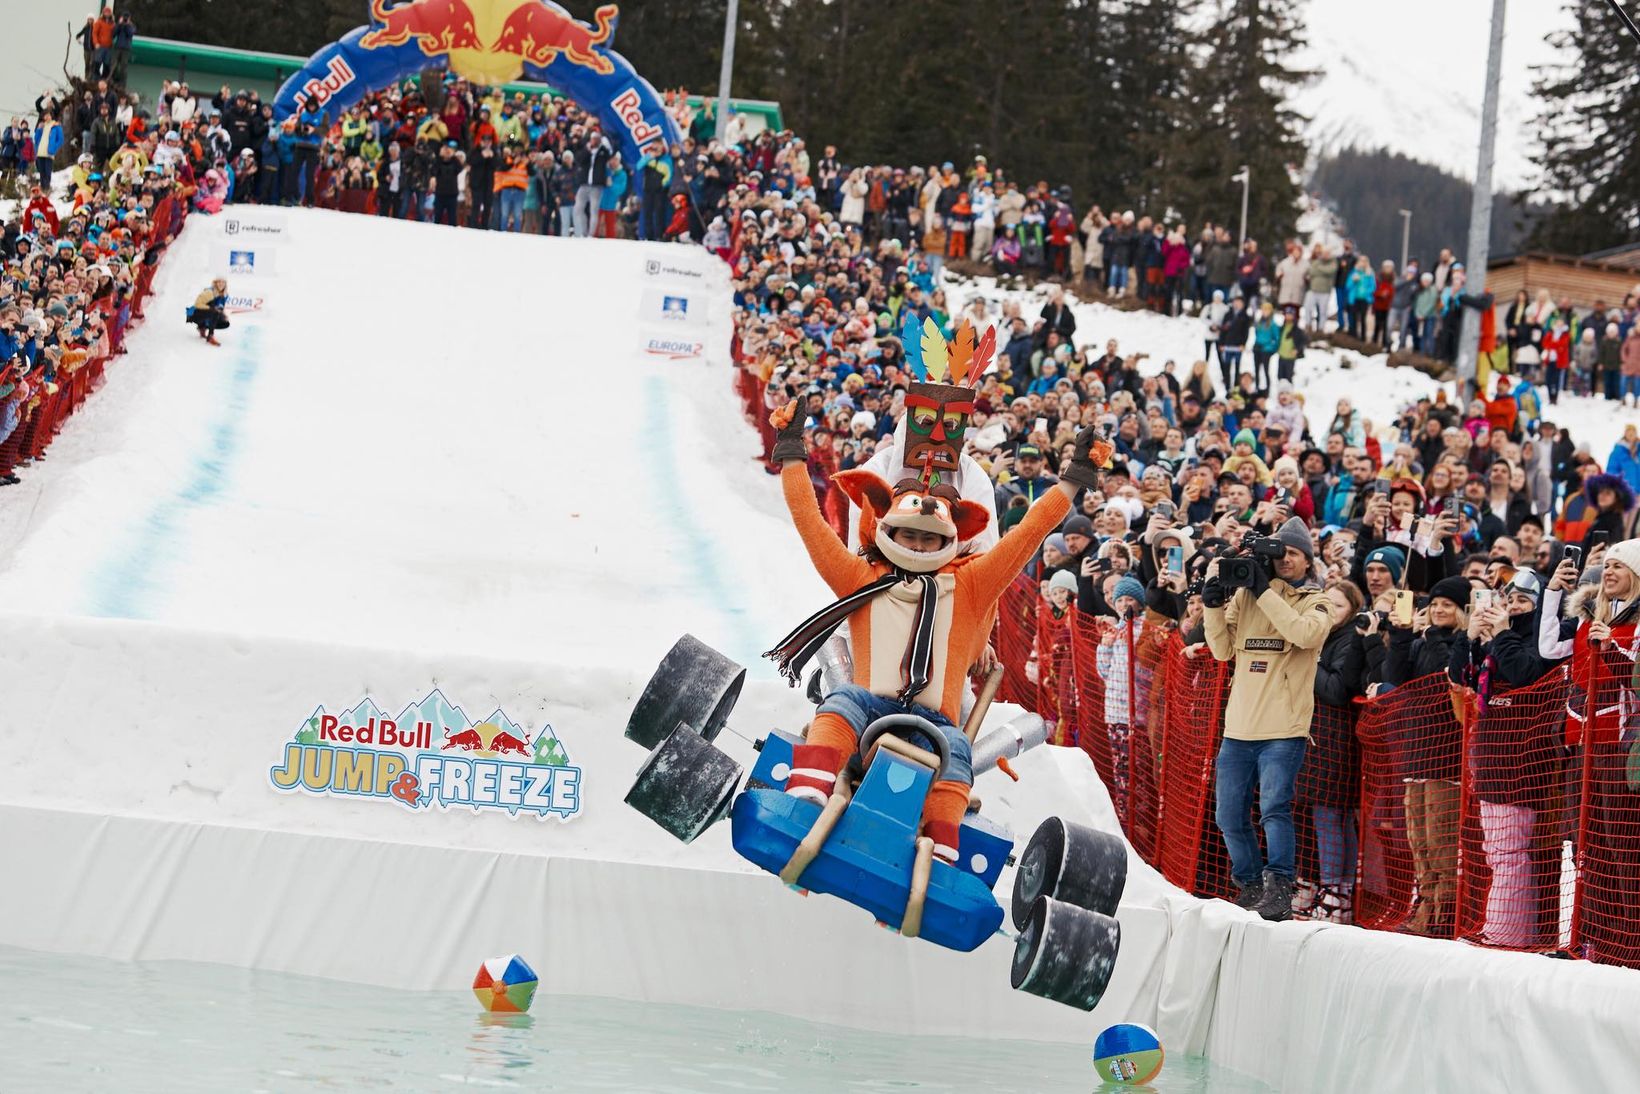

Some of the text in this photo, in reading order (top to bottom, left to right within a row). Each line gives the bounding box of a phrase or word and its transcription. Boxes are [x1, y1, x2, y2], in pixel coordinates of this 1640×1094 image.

[305, 57, 353, 104] Bull
[614, 91, 659, 142] Red
[320, 714, 432, 749] Red Bull
[273, 745, 404, 793] JUMP
[419, 756, 581, 809] FREEZE
